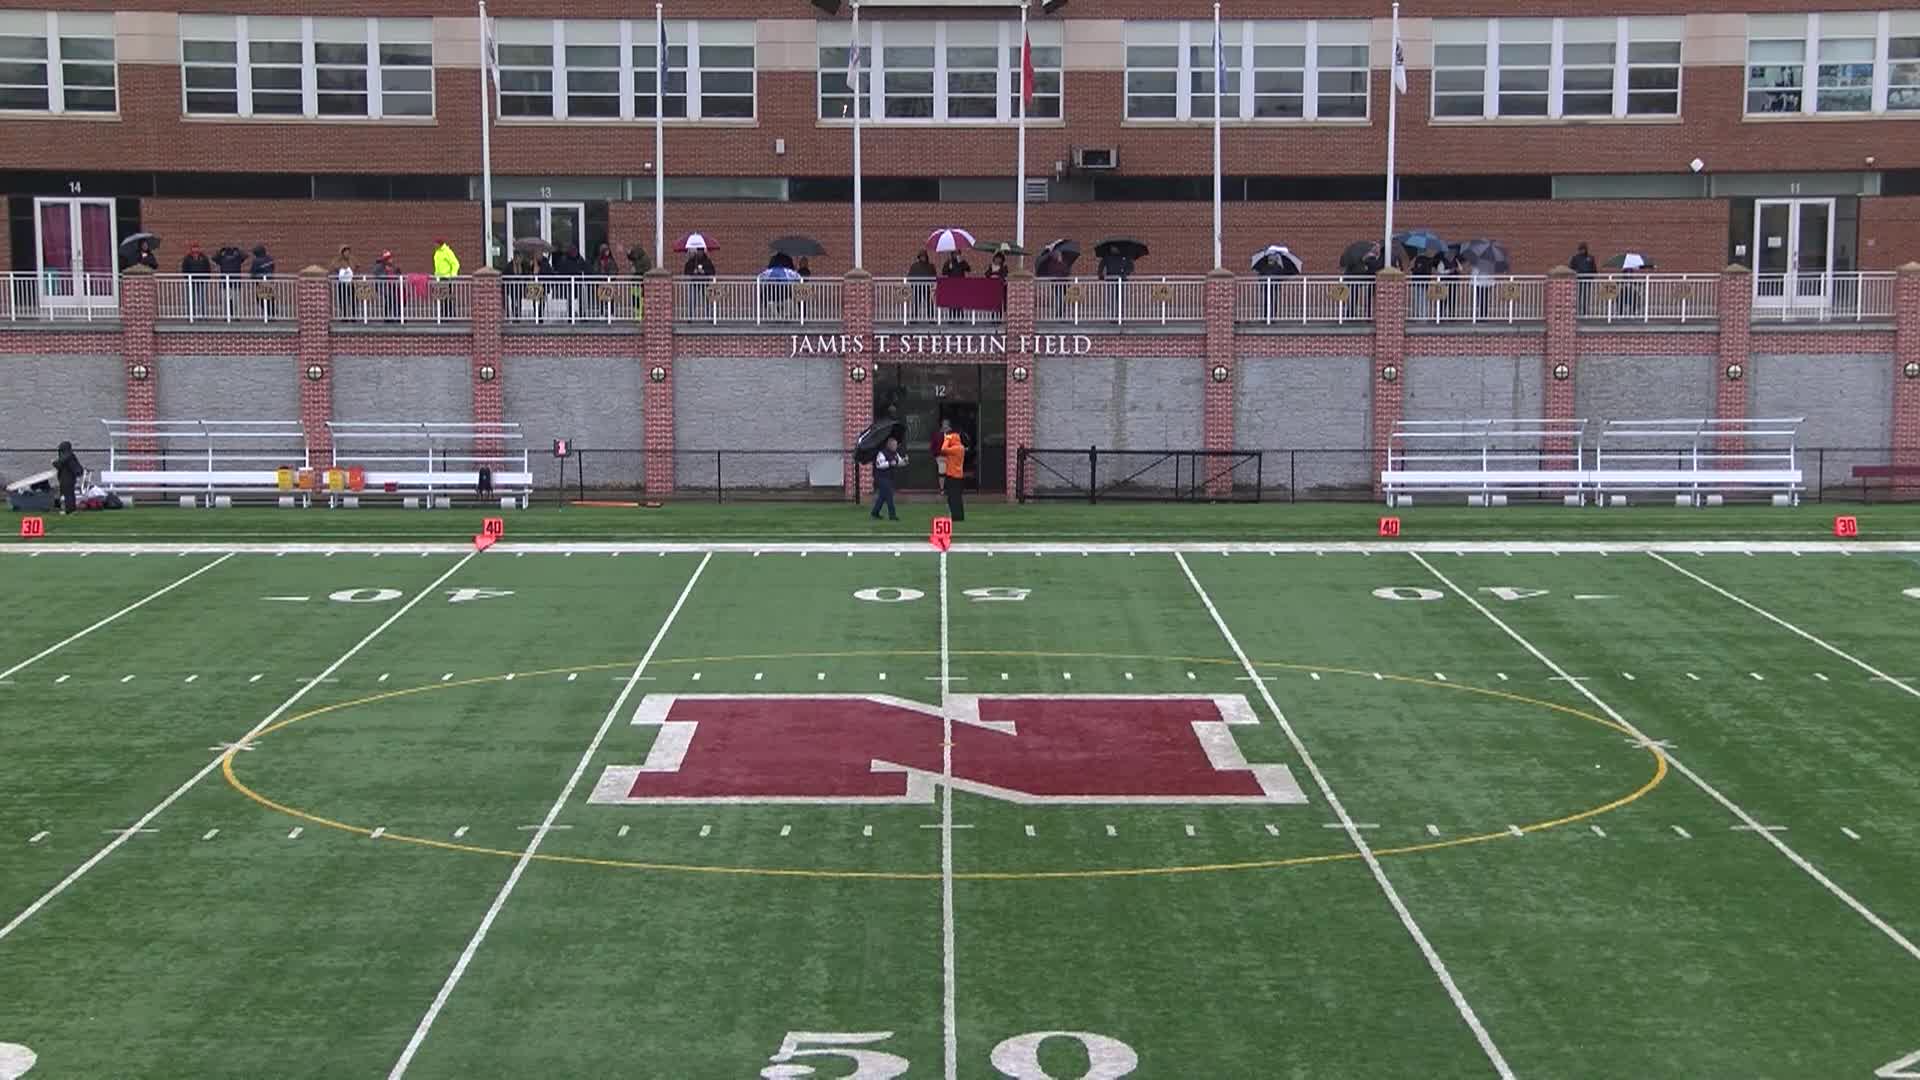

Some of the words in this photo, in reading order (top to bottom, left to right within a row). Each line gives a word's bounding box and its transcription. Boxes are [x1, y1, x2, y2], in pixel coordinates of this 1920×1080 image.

[69, 181, 81, 194] 14
[541, 186, 552, 199] 13
[1790, 183, 1800, 195] 11
[790, 335, 864, 357] JAMES
[874, 335, 891, 353] T.
[900, 334, 1007, 353] STEHLIN
[1020, 335, 1092, 353] FIELD
[935, 384, 946, 397] 12
[23, 519, 41, 534] 30
[486, 520, 501, 534] 40
[935, 520, 951, 534] 50
[1382, 519, 1398, 534] 40
[1839, 519, 1856, 533] 30
[587, 693, 1309, 804] N
